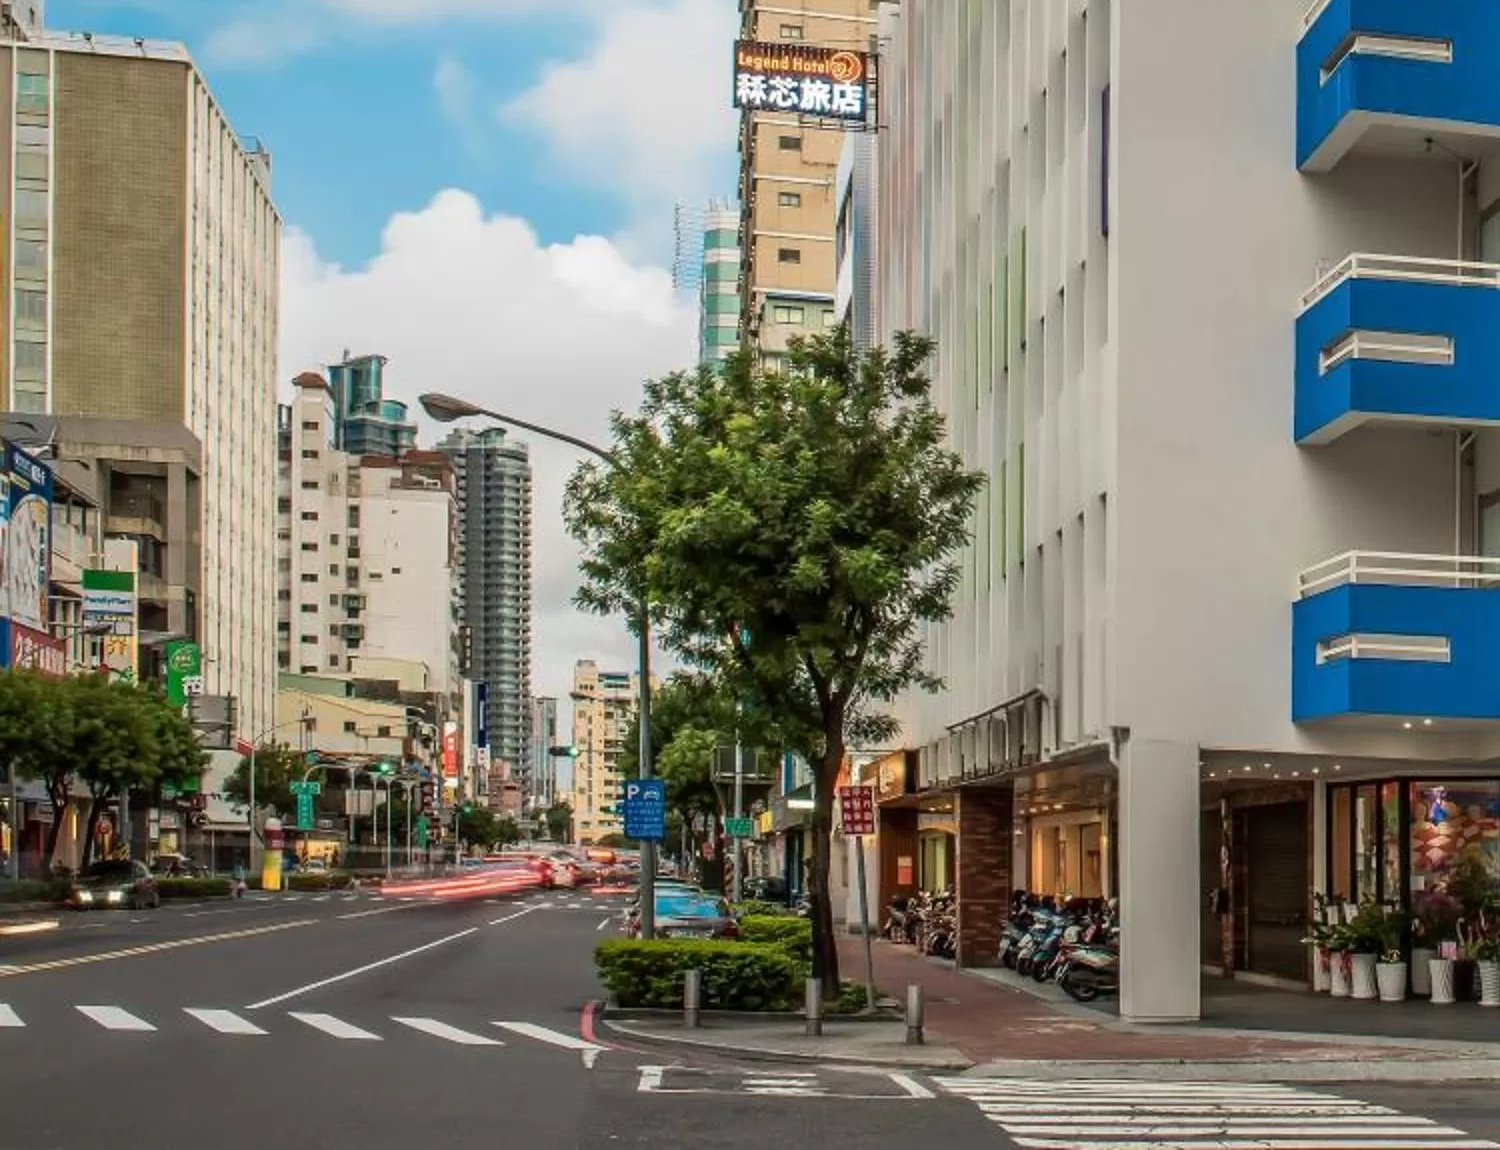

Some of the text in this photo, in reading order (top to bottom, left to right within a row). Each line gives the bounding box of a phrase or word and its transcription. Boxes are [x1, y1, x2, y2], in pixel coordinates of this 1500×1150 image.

[738, 51, 829, 73] Legend Hotel
[736, 73, 863, 113] 秝芯旅店
[627, 784, 640, 800] P
